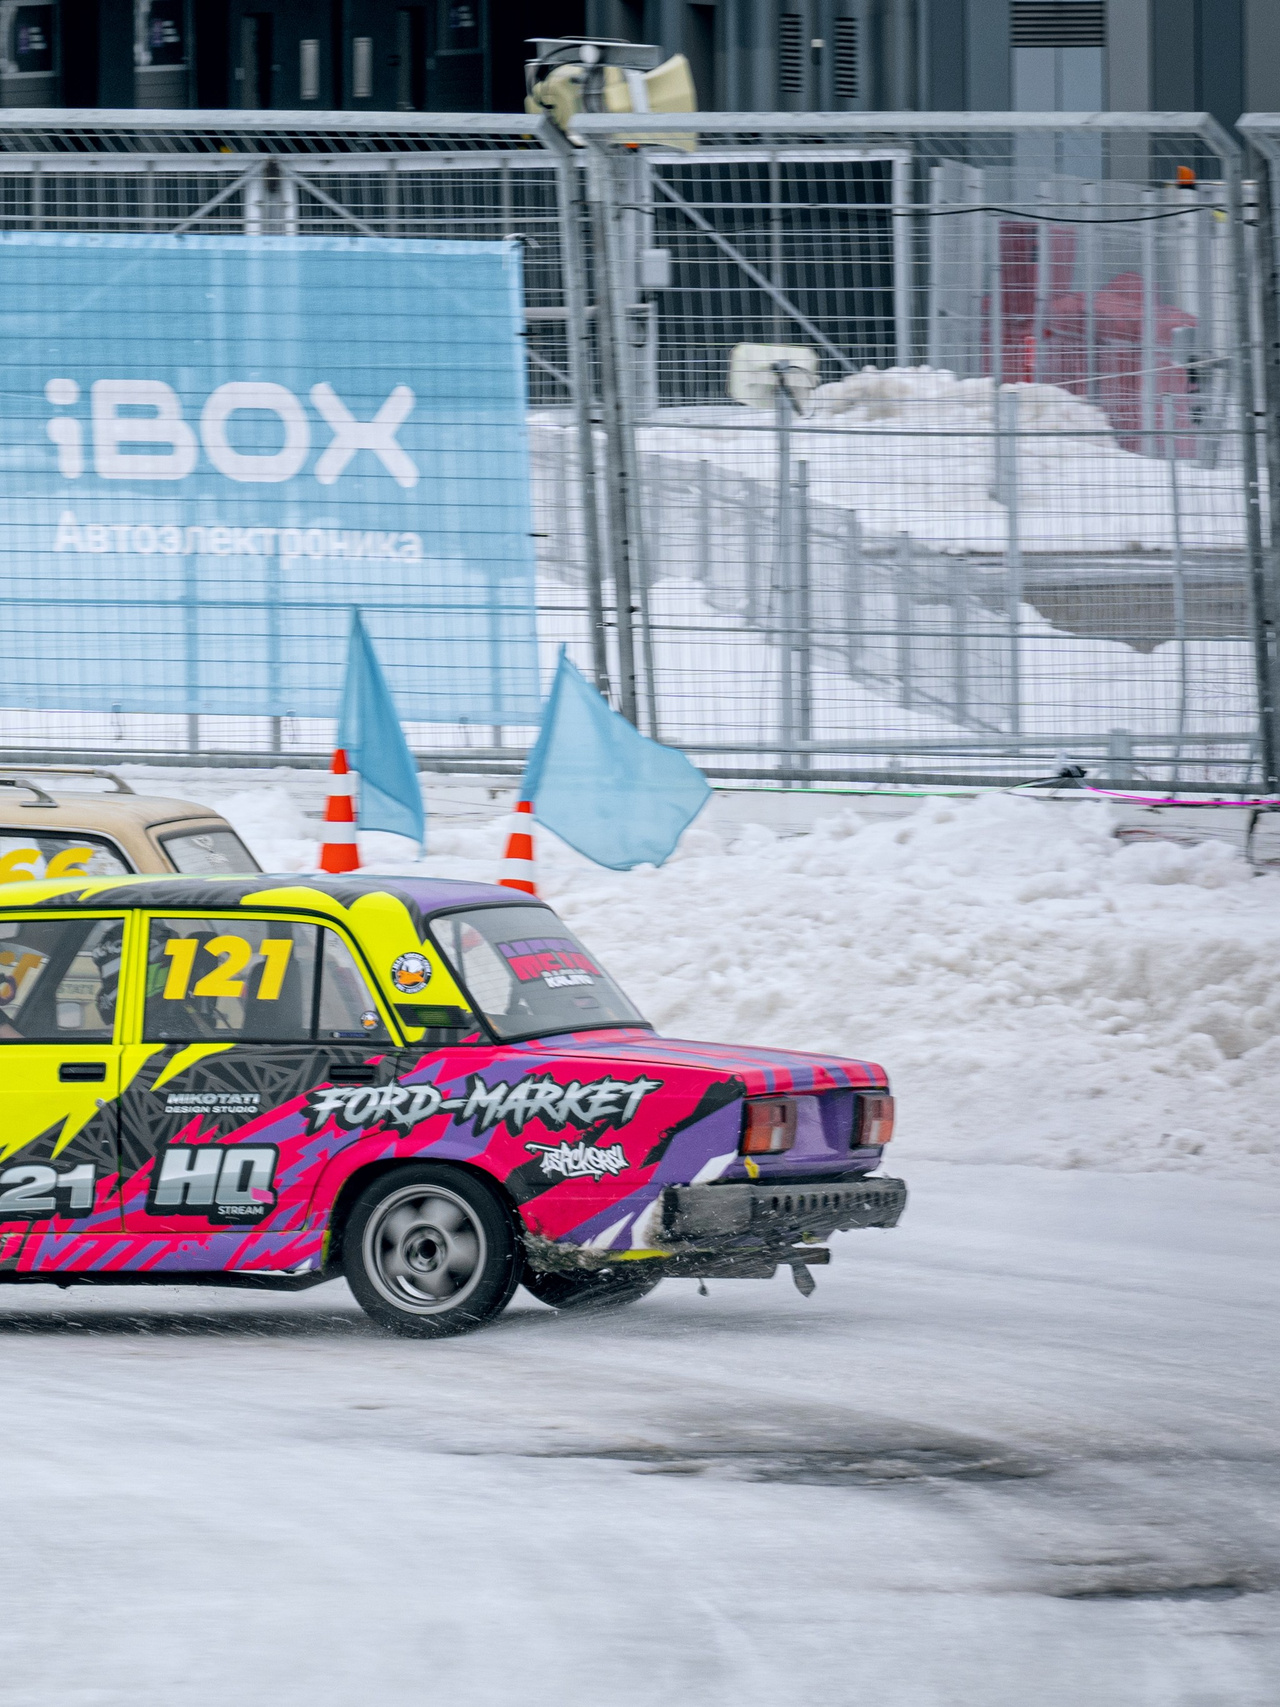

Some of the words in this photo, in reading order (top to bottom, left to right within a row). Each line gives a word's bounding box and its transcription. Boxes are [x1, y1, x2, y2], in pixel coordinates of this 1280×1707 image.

[44, 378, 420, 489] iBOX
[53, 510, 424, 570] Автоэлектроника
[163, 935, 294, 1000] 121
[165, 1105, 210, 1113] DESIGN
[211, 1105, 258, 1113] STUDIO
[166, 1093, 261, 1104] MIKOTATI
[308, 1074, 665, 1132] FORD-MARKET
[154, 1148, 277, 1205] HQ
[217, 1205, 264, 1215] STREAM
